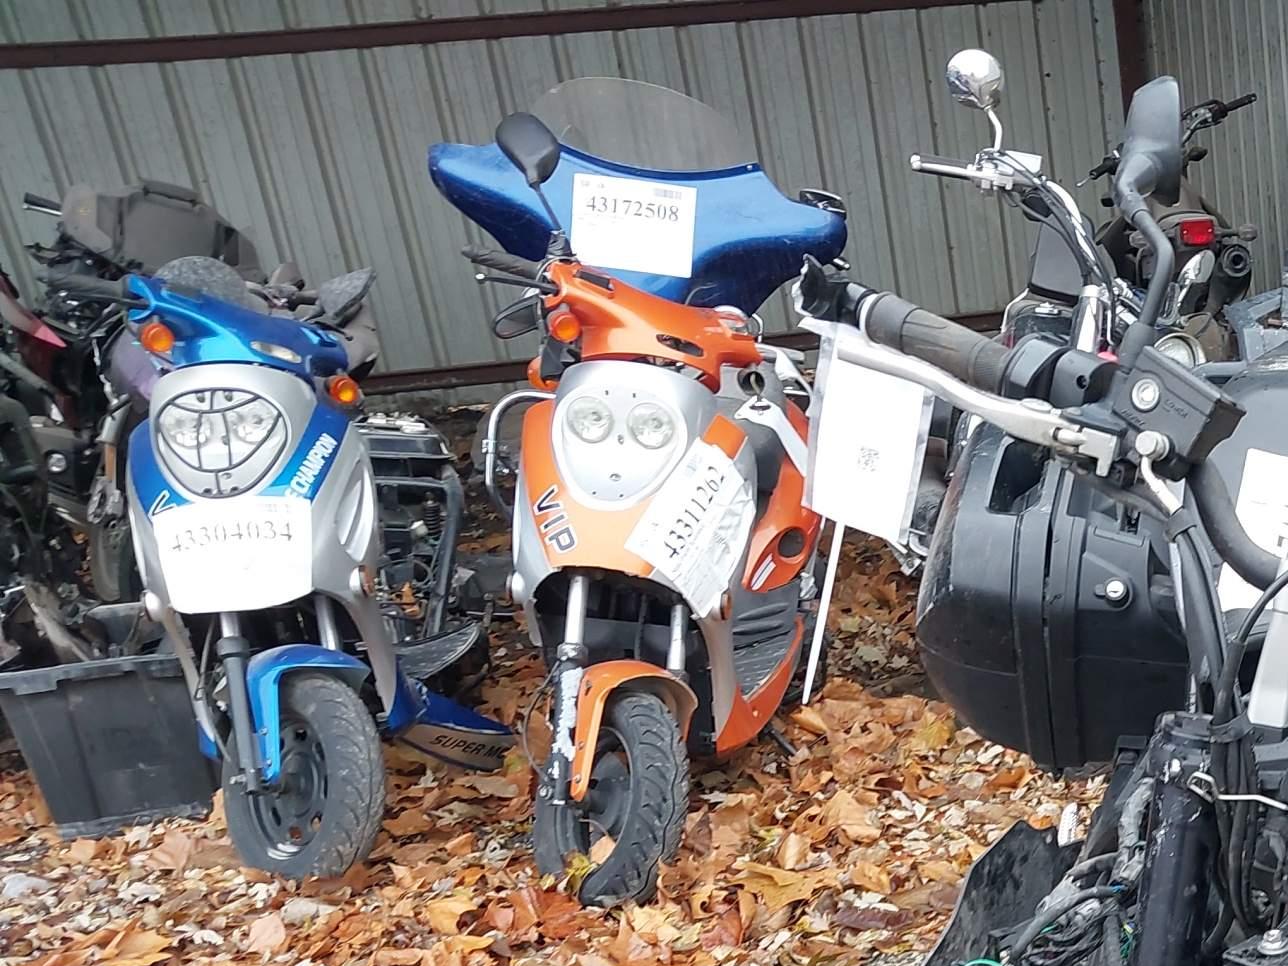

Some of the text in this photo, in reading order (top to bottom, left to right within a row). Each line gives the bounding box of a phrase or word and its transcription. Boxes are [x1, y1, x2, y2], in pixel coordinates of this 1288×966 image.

[586, 195, 679, 222] 43172508
[290, 432, 338, 494] CHAMPION
[171, 520, 293, 551] 43304034
[534, 484, 577, 554] VIP
[664, 465, 725, 559] 43311262
